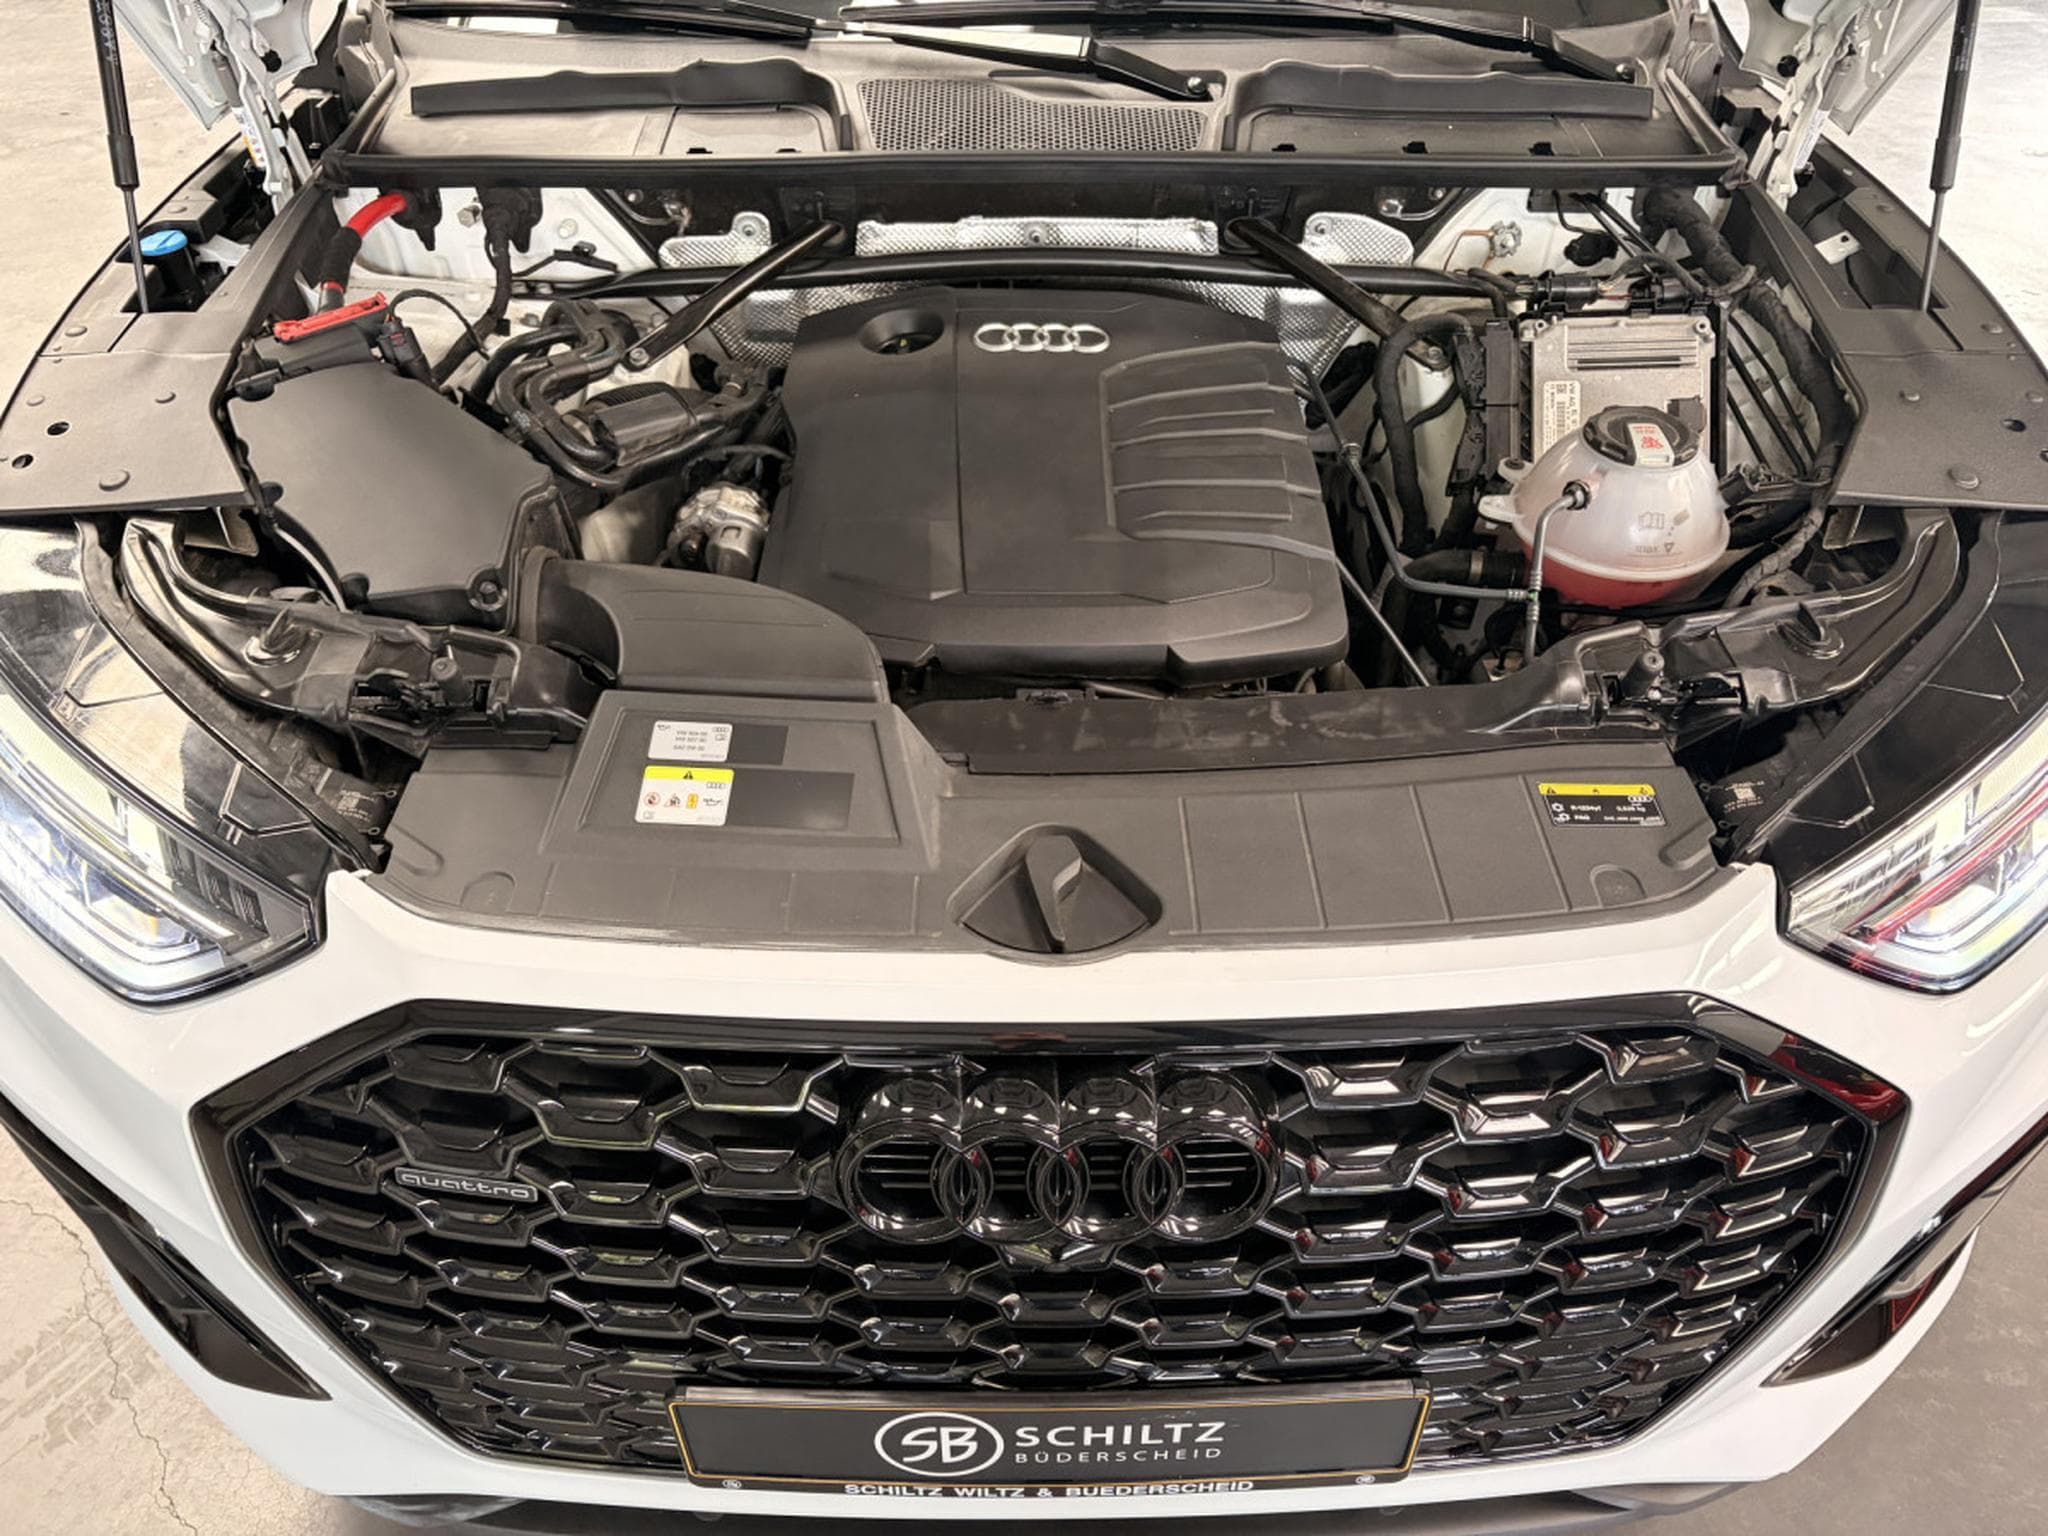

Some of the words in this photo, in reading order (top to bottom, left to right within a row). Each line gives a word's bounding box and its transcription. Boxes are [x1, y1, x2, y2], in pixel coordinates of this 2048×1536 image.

[401, 1172, 530, 1199] quattro
[901, 1426, 978, 1464] SB
[1015, 1421, 1226, 1448] SCHILTZ
[1015, 1447, 1223, 1464] BÜDERSCHEID
[844, 1483, 943, 1497] SCHILTZ
[955, 1486, 1025, 1498] WILTZ
[1037, 1487, 1053, 1498] &
[1066, 1480, 1254, 1498] BUEDERSCHEID
